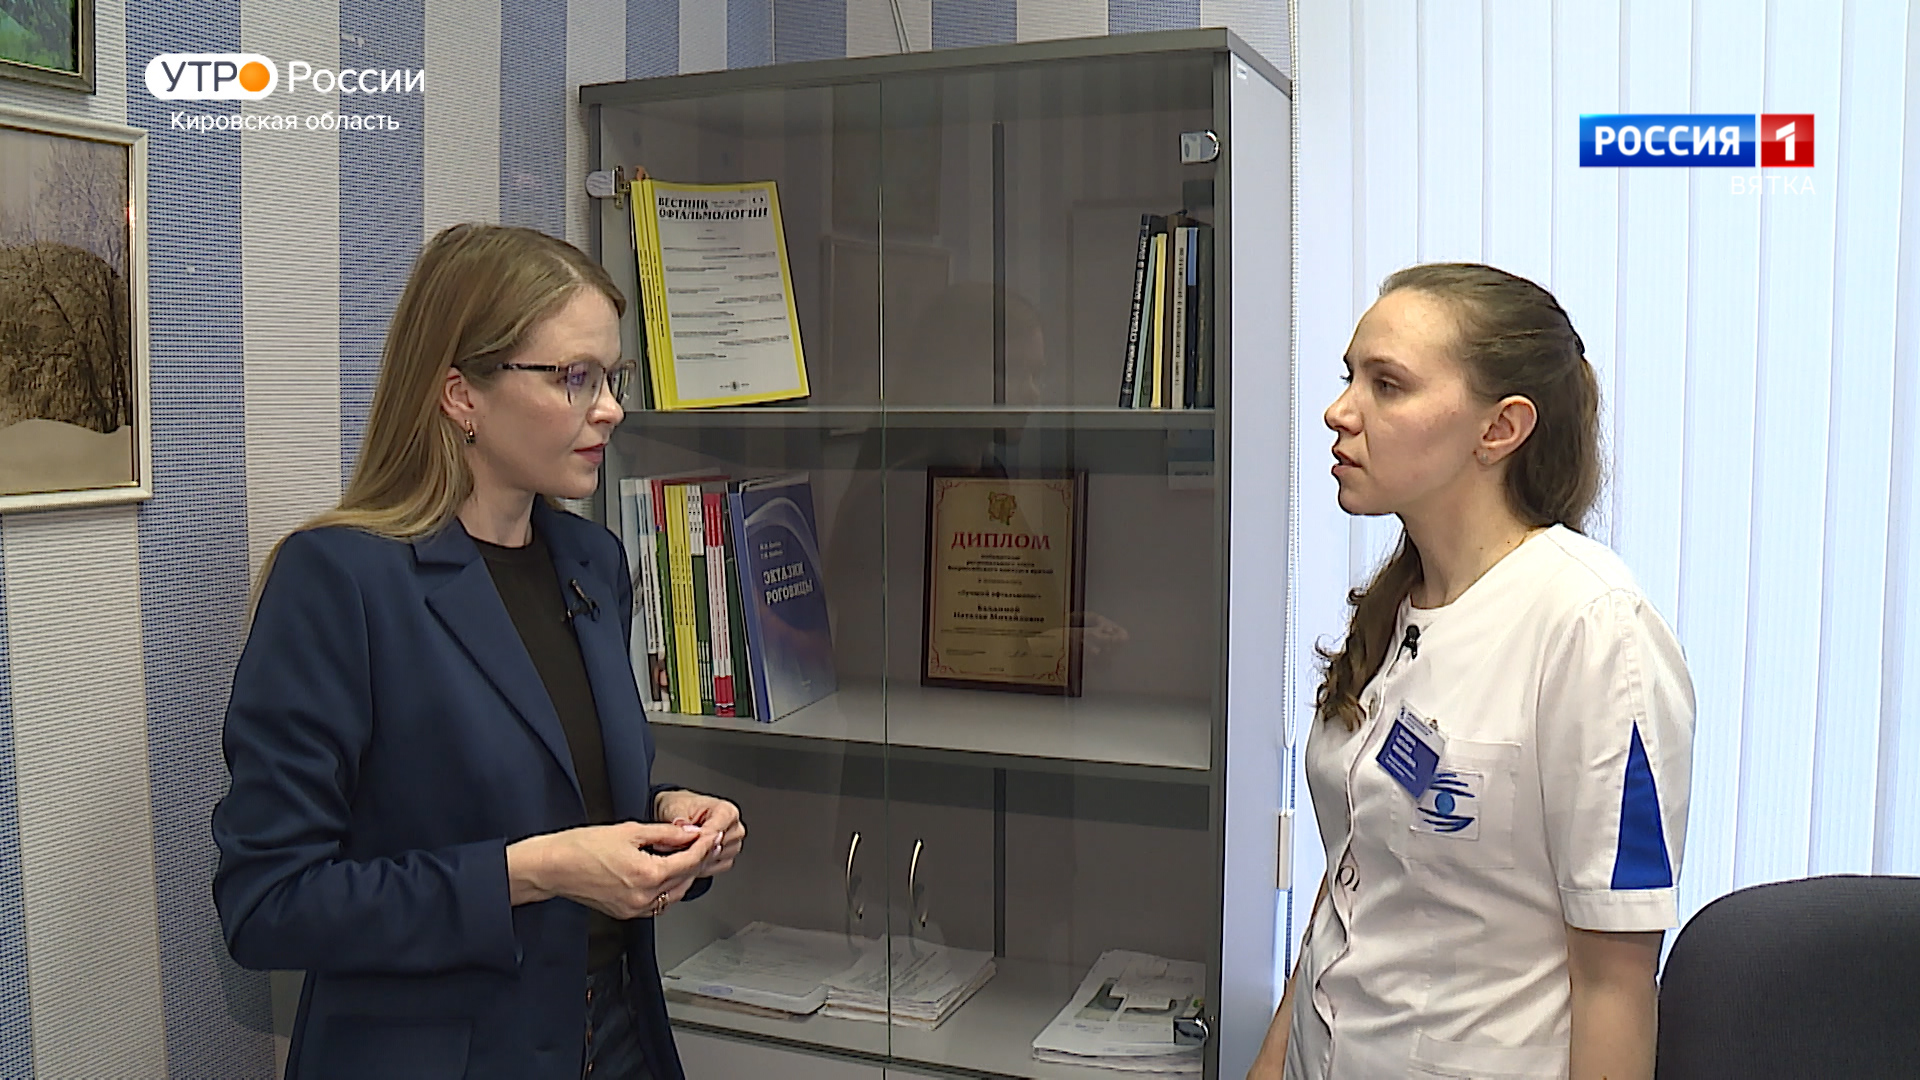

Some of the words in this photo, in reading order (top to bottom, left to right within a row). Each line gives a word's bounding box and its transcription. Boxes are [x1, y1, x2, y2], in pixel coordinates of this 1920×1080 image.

[658, 196, 709, 210] ВЕСТНИК
[659, 207, 768, 220] ОФТАЛЬМОЛОГИИ
[950, 531, 1051, 550] ДИПЛОМ
[763, 561, 804, 584] ЭКТАЗИИ
[765, 578, 813, 606] РОГОВИЦЫ
